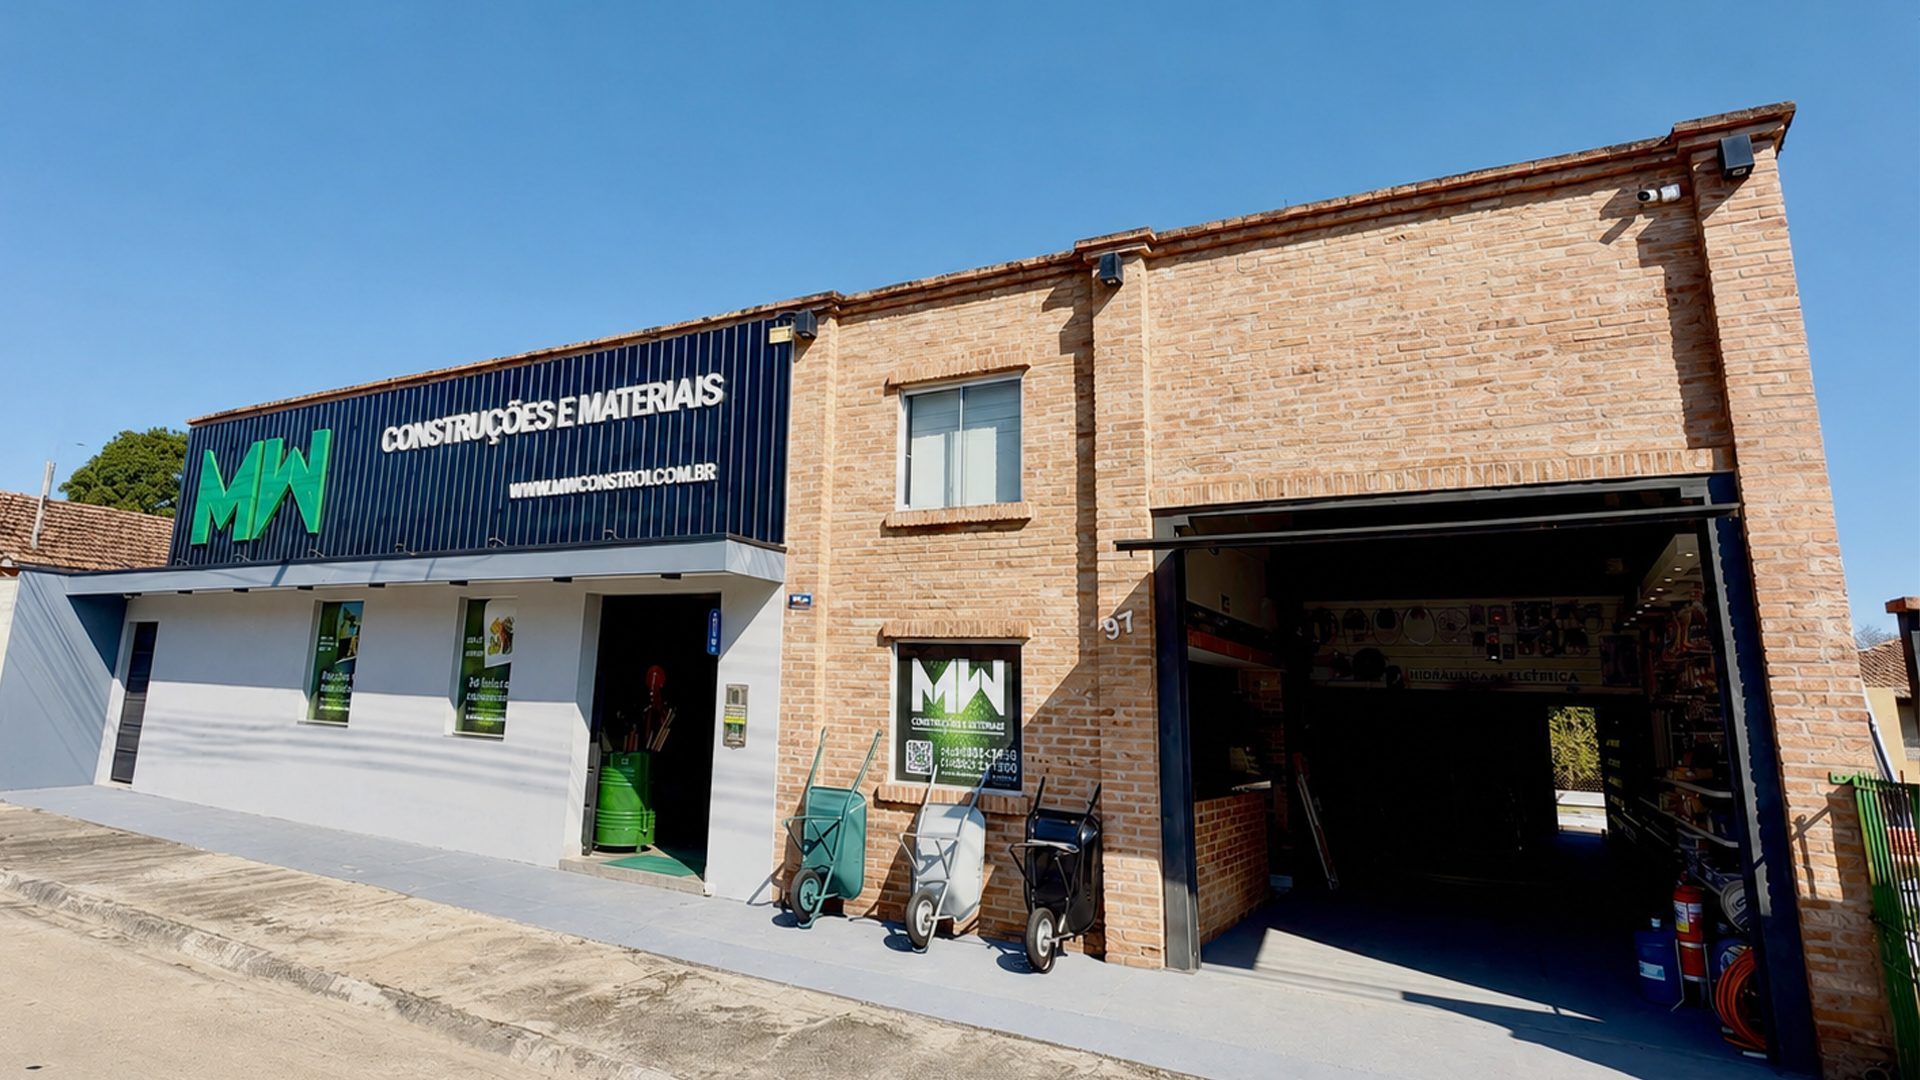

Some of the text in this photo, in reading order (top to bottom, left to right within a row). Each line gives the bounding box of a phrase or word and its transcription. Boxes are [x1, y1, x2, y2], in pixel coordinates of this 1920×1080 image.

[382, 373, 725, 453] CONSTRUÇÕES E MATERIAIS
[190, 428, 332, 546] MW
[1102, 609, 1133, 640] 97
[911, 657, 1005, 716] MW
